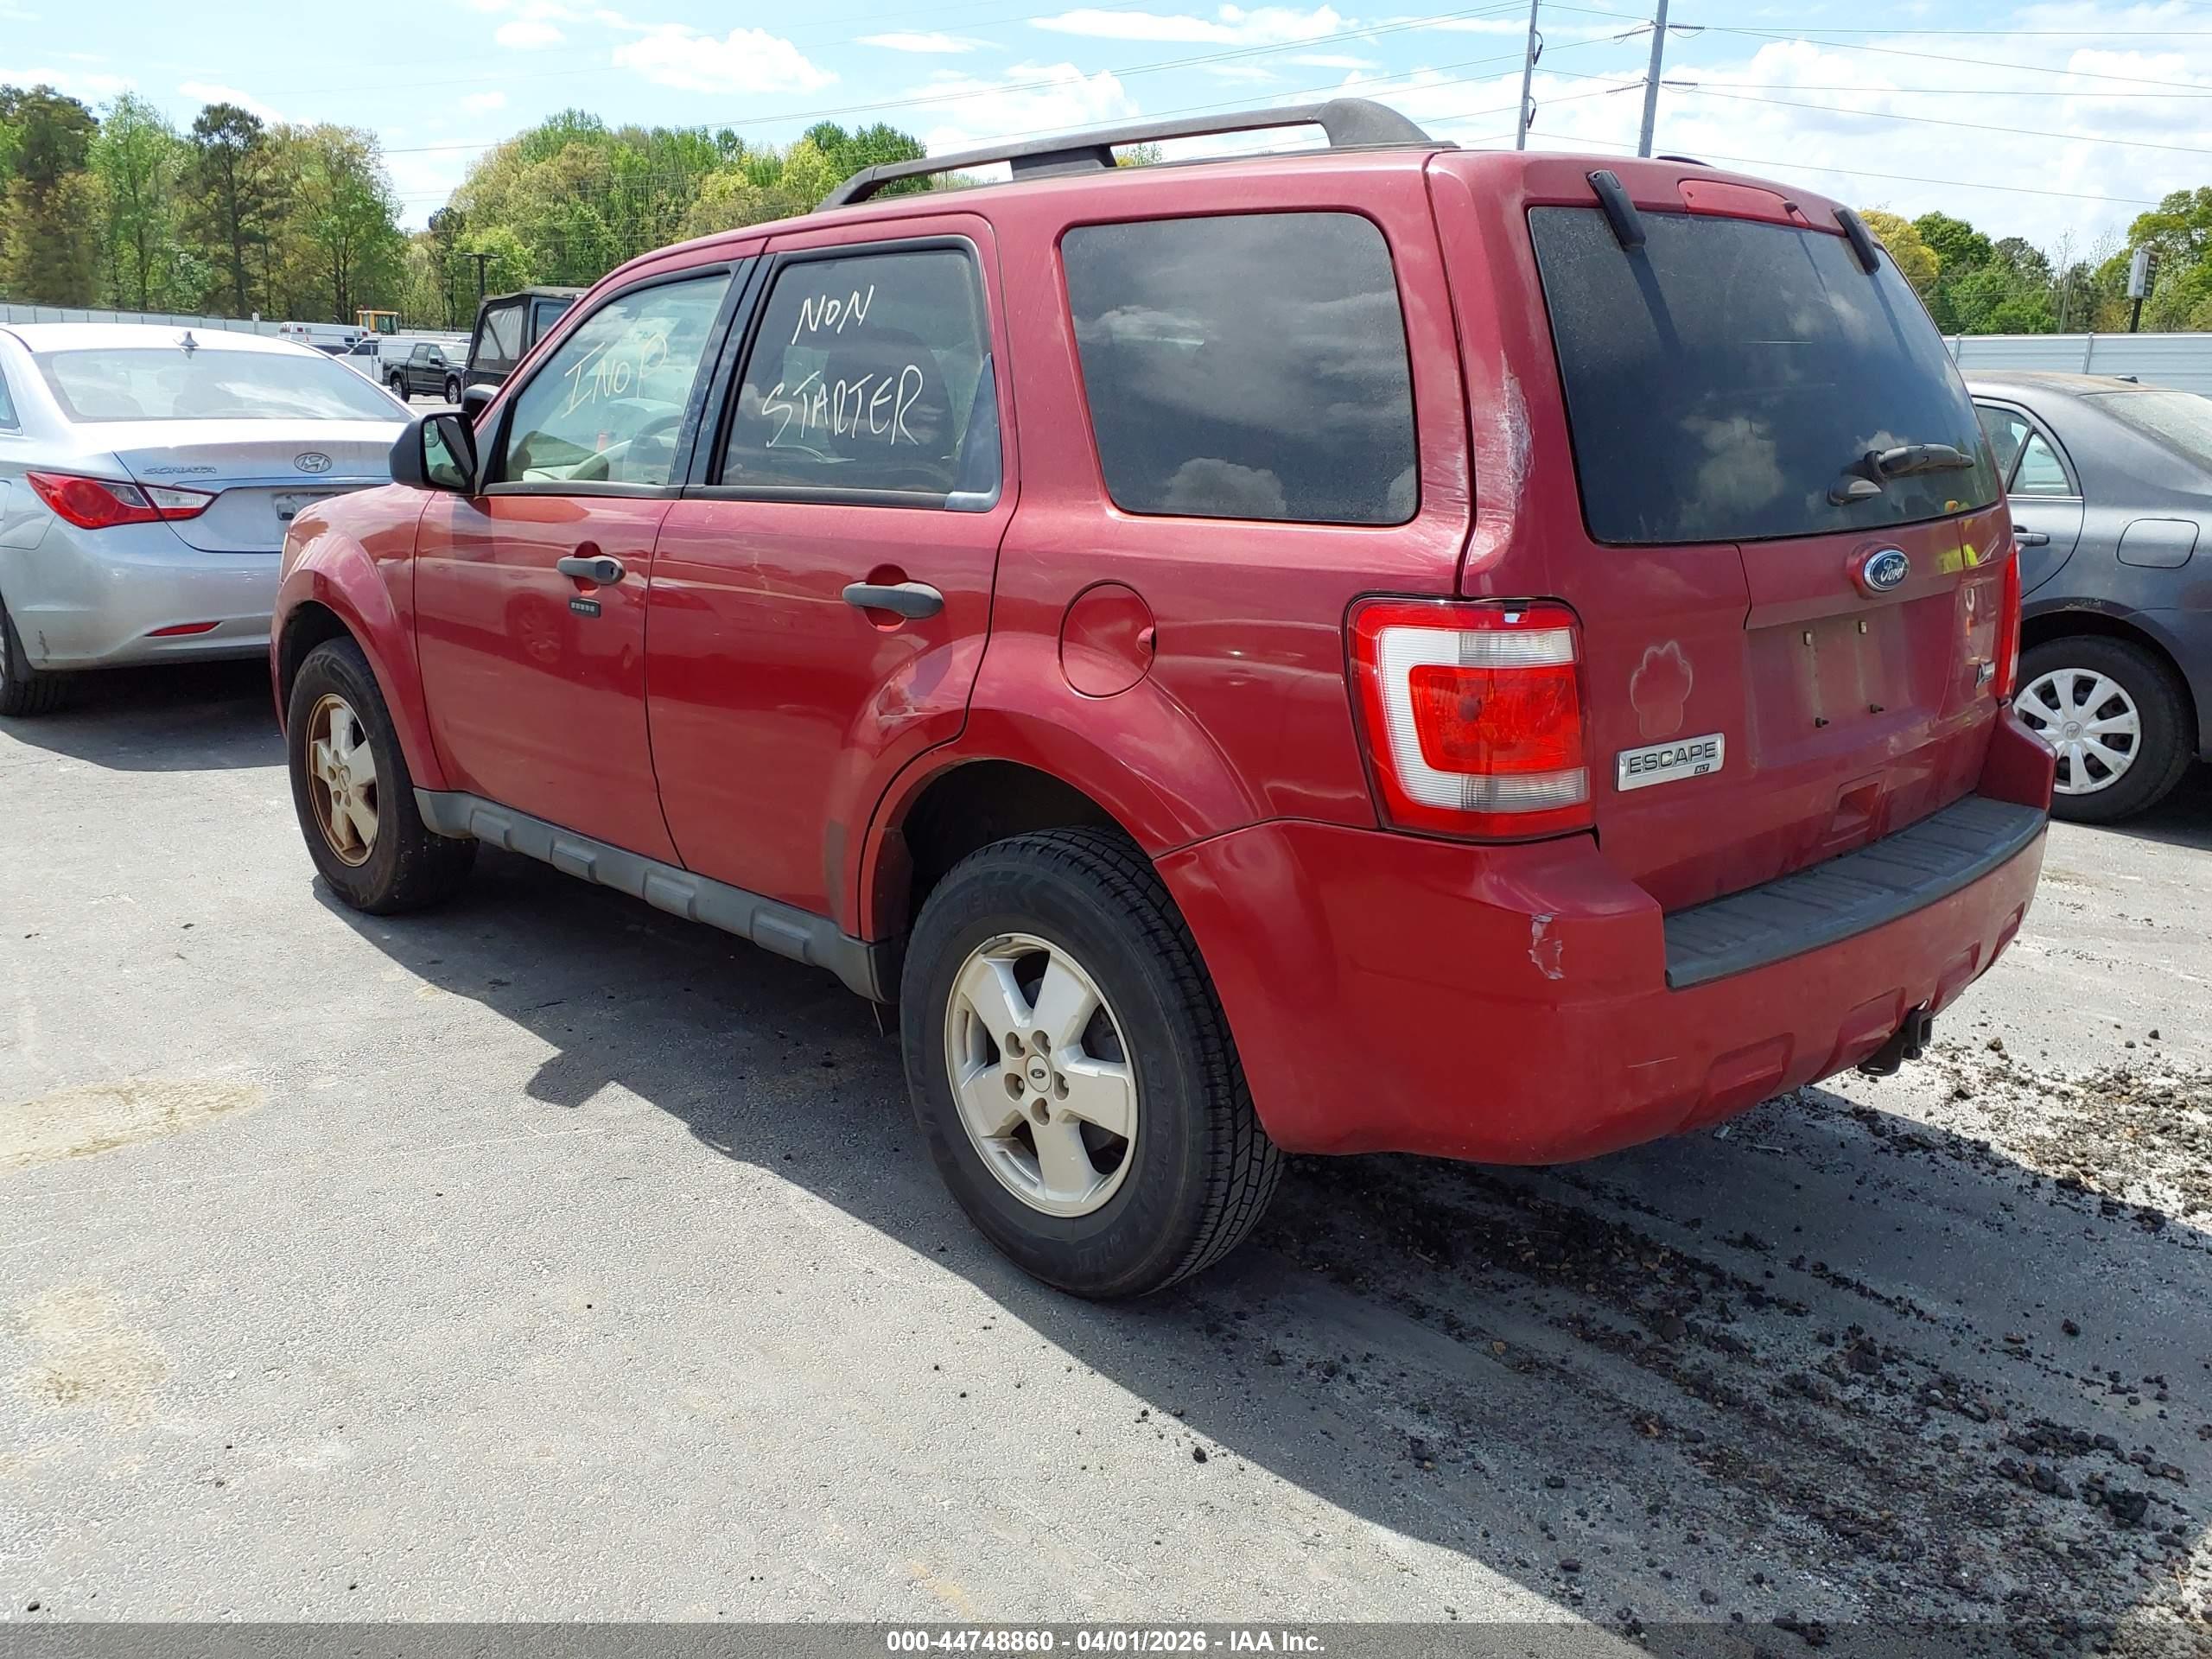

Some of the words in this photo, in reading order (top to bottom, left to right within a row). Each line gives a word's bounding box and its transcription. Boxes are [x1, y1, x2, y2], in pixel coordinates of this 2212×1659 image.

[791, 283, 874, 346] NON
[561, 332, 667, 419] INOP
[761, 364, 924, 448] STARTER
[143, 466, 216, 474] SONATA
[1880, 557, 1905, 582] Ford
[1630, 741, 1716, 773] ESCAPE
[1694, 764, 1710, 774] XLT
